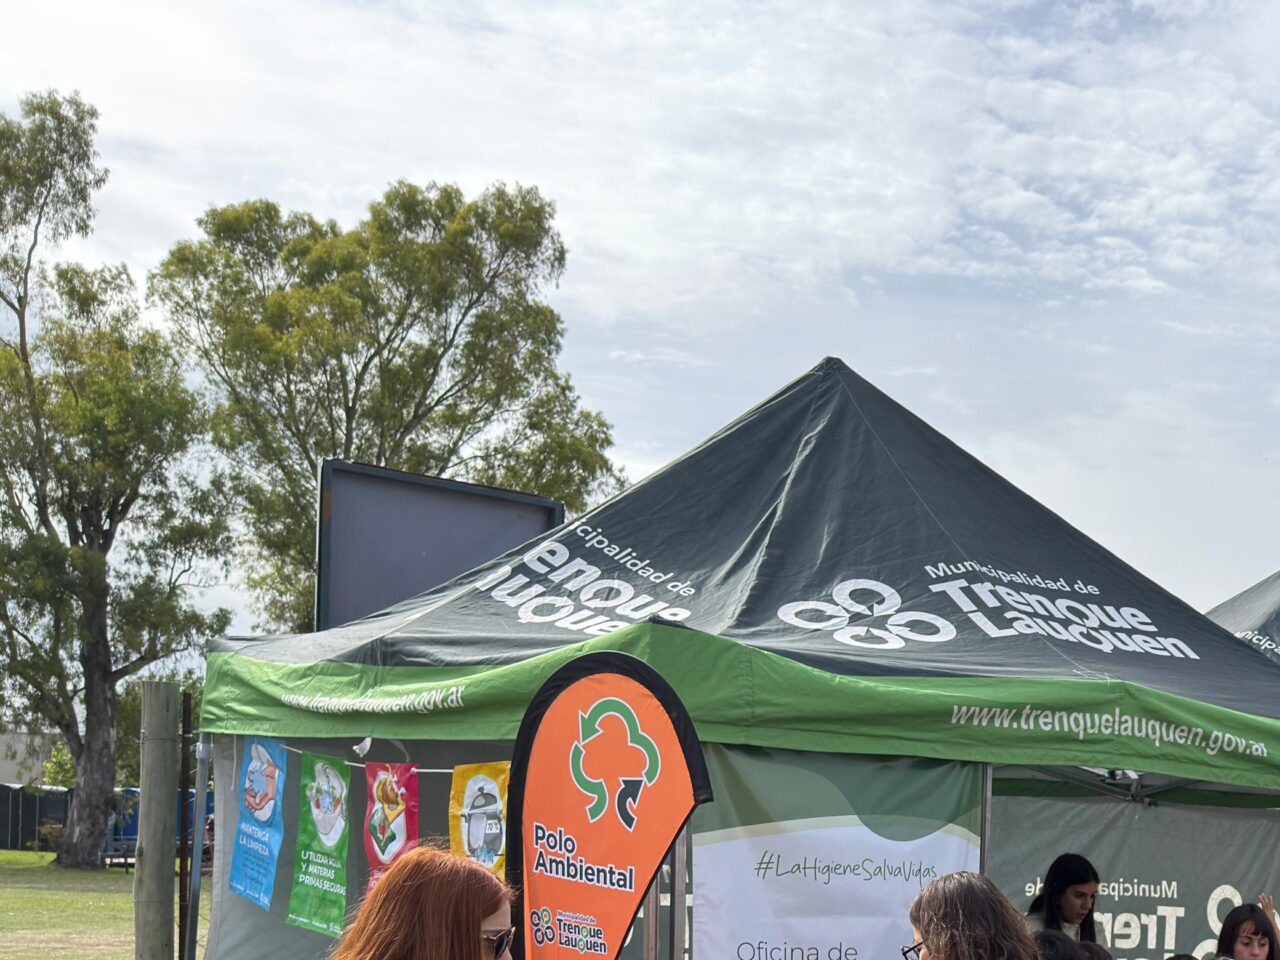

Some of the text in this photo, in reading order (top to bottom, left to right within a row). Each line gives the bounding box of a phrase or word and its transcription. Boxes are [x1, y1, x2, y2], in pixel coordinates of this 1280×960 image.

[575, 521, 673, 584] cipalidad
[924, 562, 1100, 596] Municipalidad de
[951, 704, 1268, 758] www.trenquelauquen.gov.ar
[534, 822, 576, 855] Polo
[534, 850, 634, 891] Ambiental
[754, 850, 938, 888] #LaHigieneSalvaVidas
